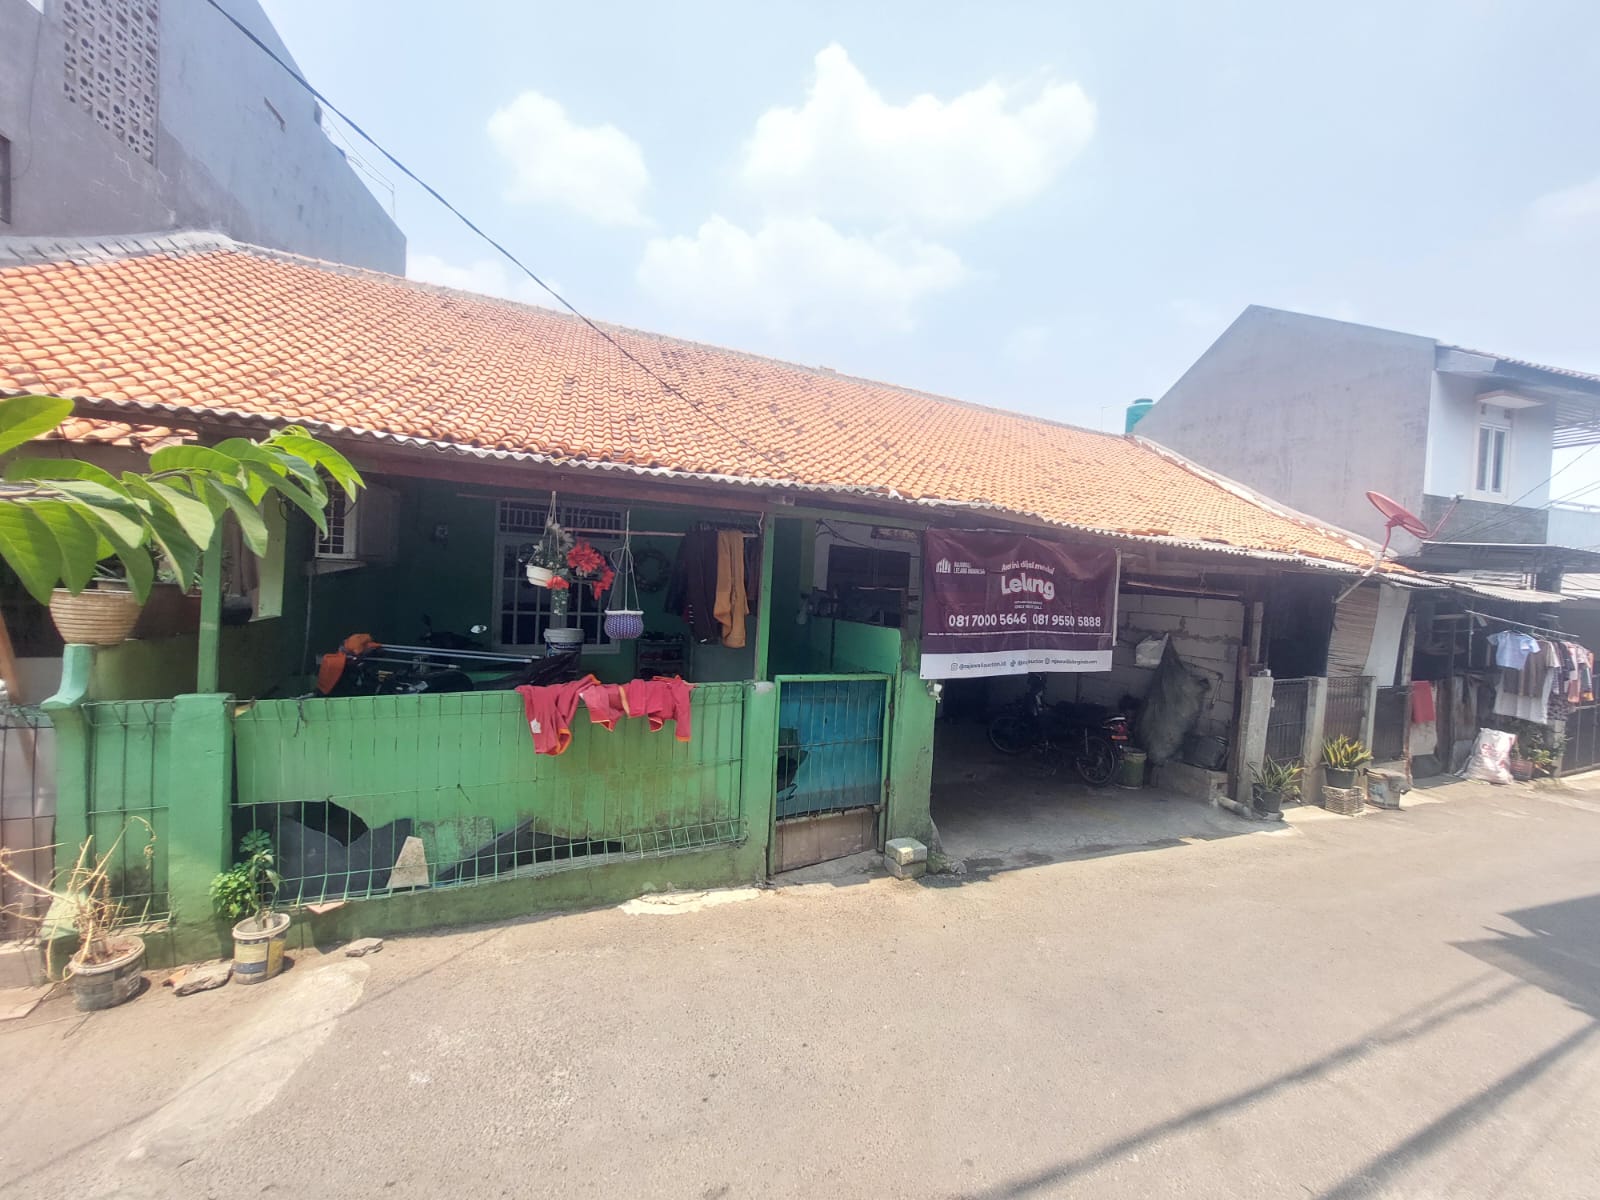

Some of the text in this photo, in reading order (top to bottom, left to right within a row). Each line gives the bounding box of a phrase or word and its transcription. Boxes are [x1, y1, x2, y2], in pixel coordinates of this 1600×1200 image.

[948, 613, 1101, 627] 081 7000 5646 081 9550 5888
